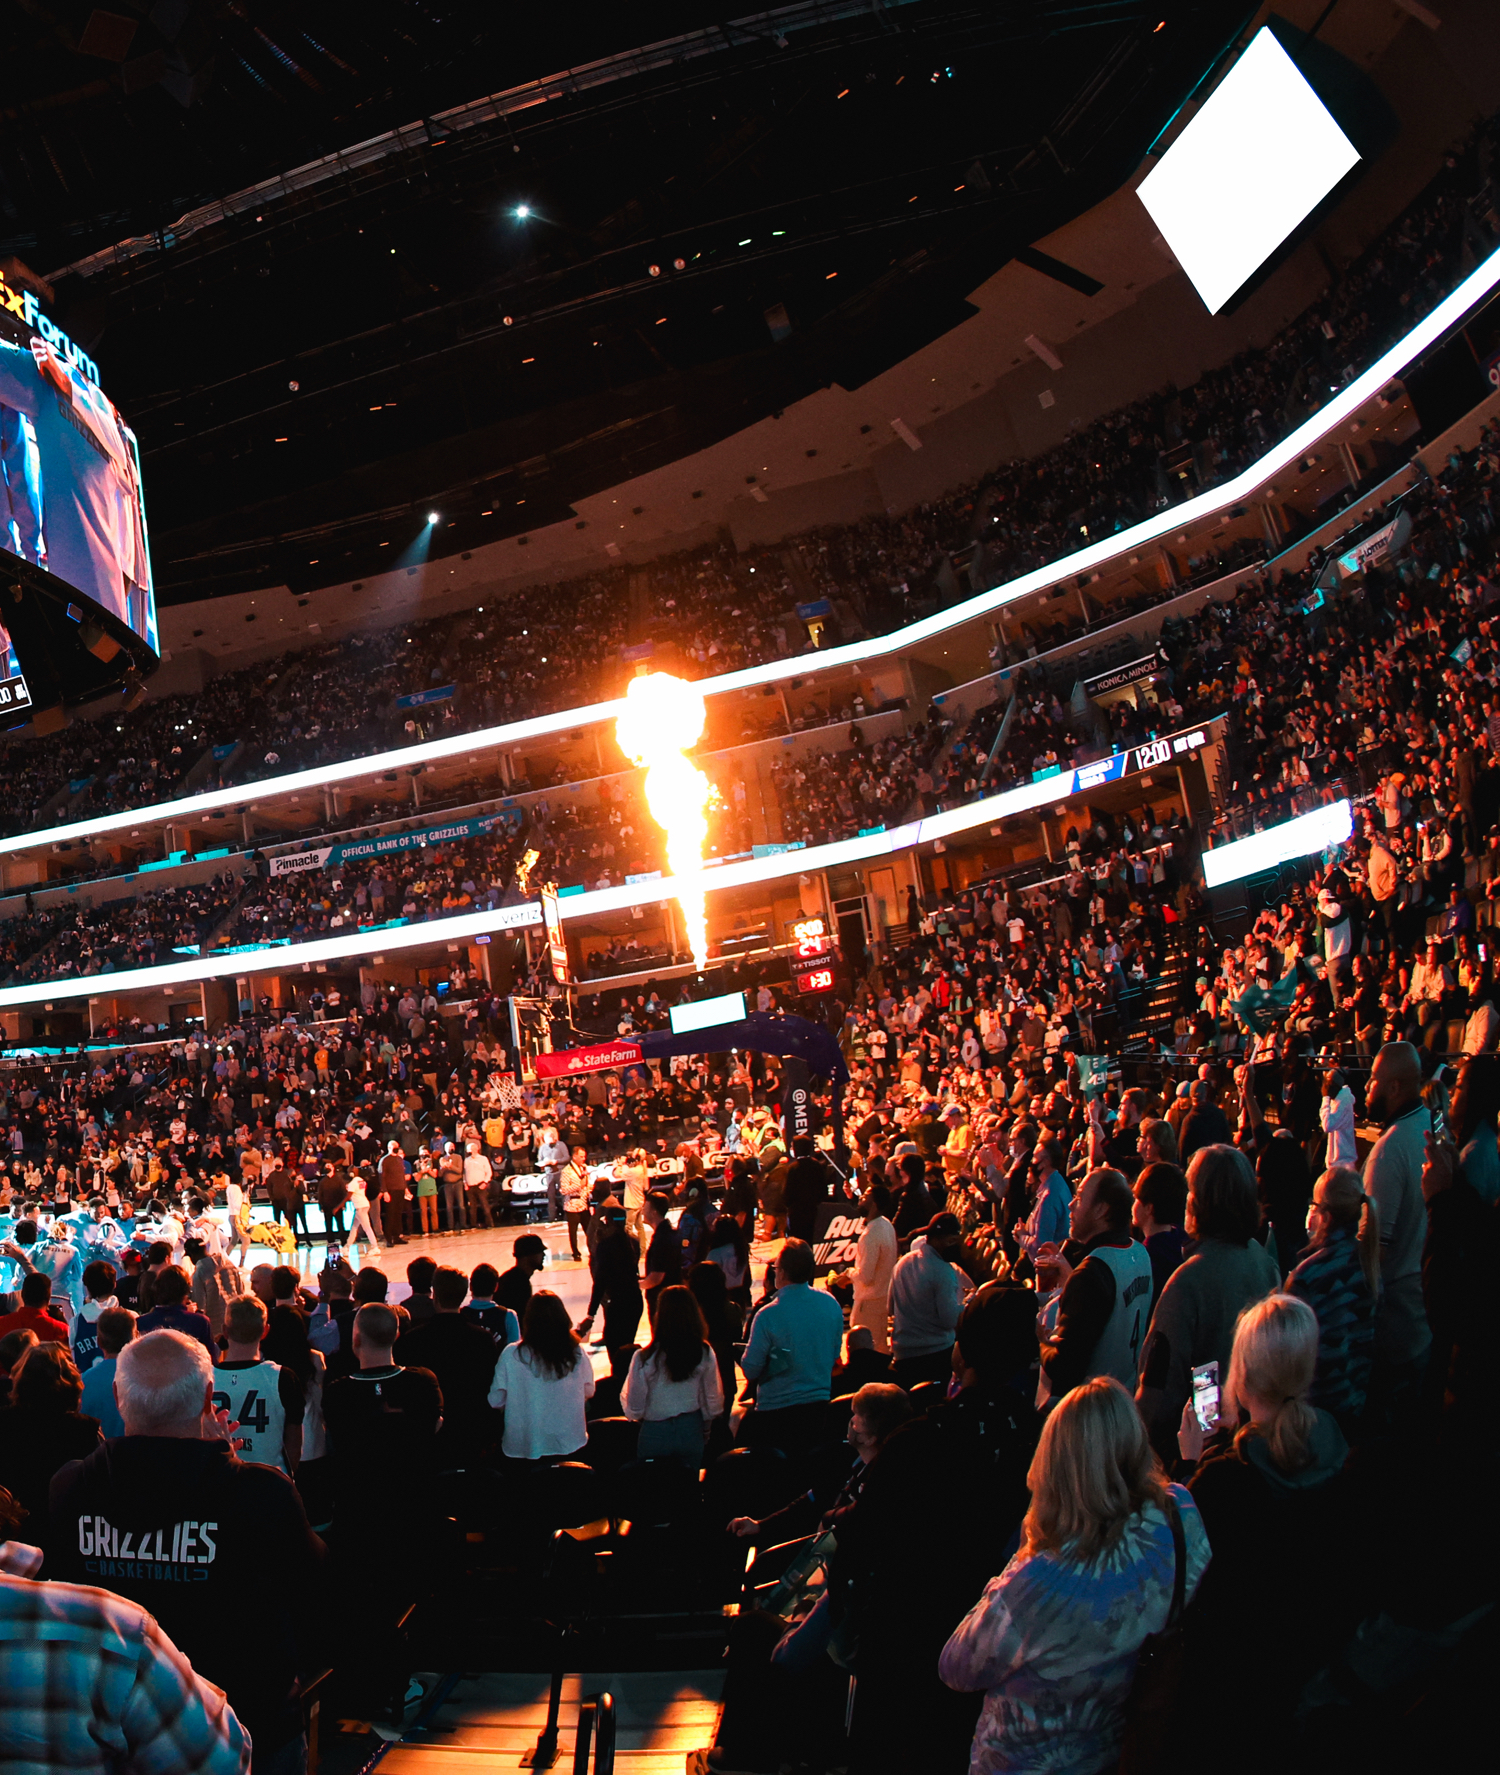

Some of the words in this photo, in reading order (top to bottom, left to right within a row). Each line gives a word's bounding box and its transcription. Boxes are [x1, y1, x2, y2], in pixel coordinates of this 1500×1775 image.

[1097, 674, 1128, 690] KONICA
[1128, 659, 1158, 678] MINOLT
[1135, 740, 1172, 770] 12:00
[276, 853, 319, 870] Pinnacle
[341, 847, 375, 858] OFFICIAL
[377, 840, 398, 851] BANK
[398, 838, 409, 847] OF
[411, 833, 427, 844] THE
[428, 825, 469, 841] GRIZZLIES
[501, 909, 540, 925] veriz
[799, 935, 821, 956] 24
[803, 956, 831, 968] TISSOT
[823, 1215, 867, 1240] Aut
[824, 1239, 858, 1264] Zo
[76, 1336, 98, 1354] BRY
[1129, 1308, 1140, 1364] 4
[78, 1515, 218, 1564] GRIZZLIES
[100, 1560, 191, 1582] BASKETBALL
